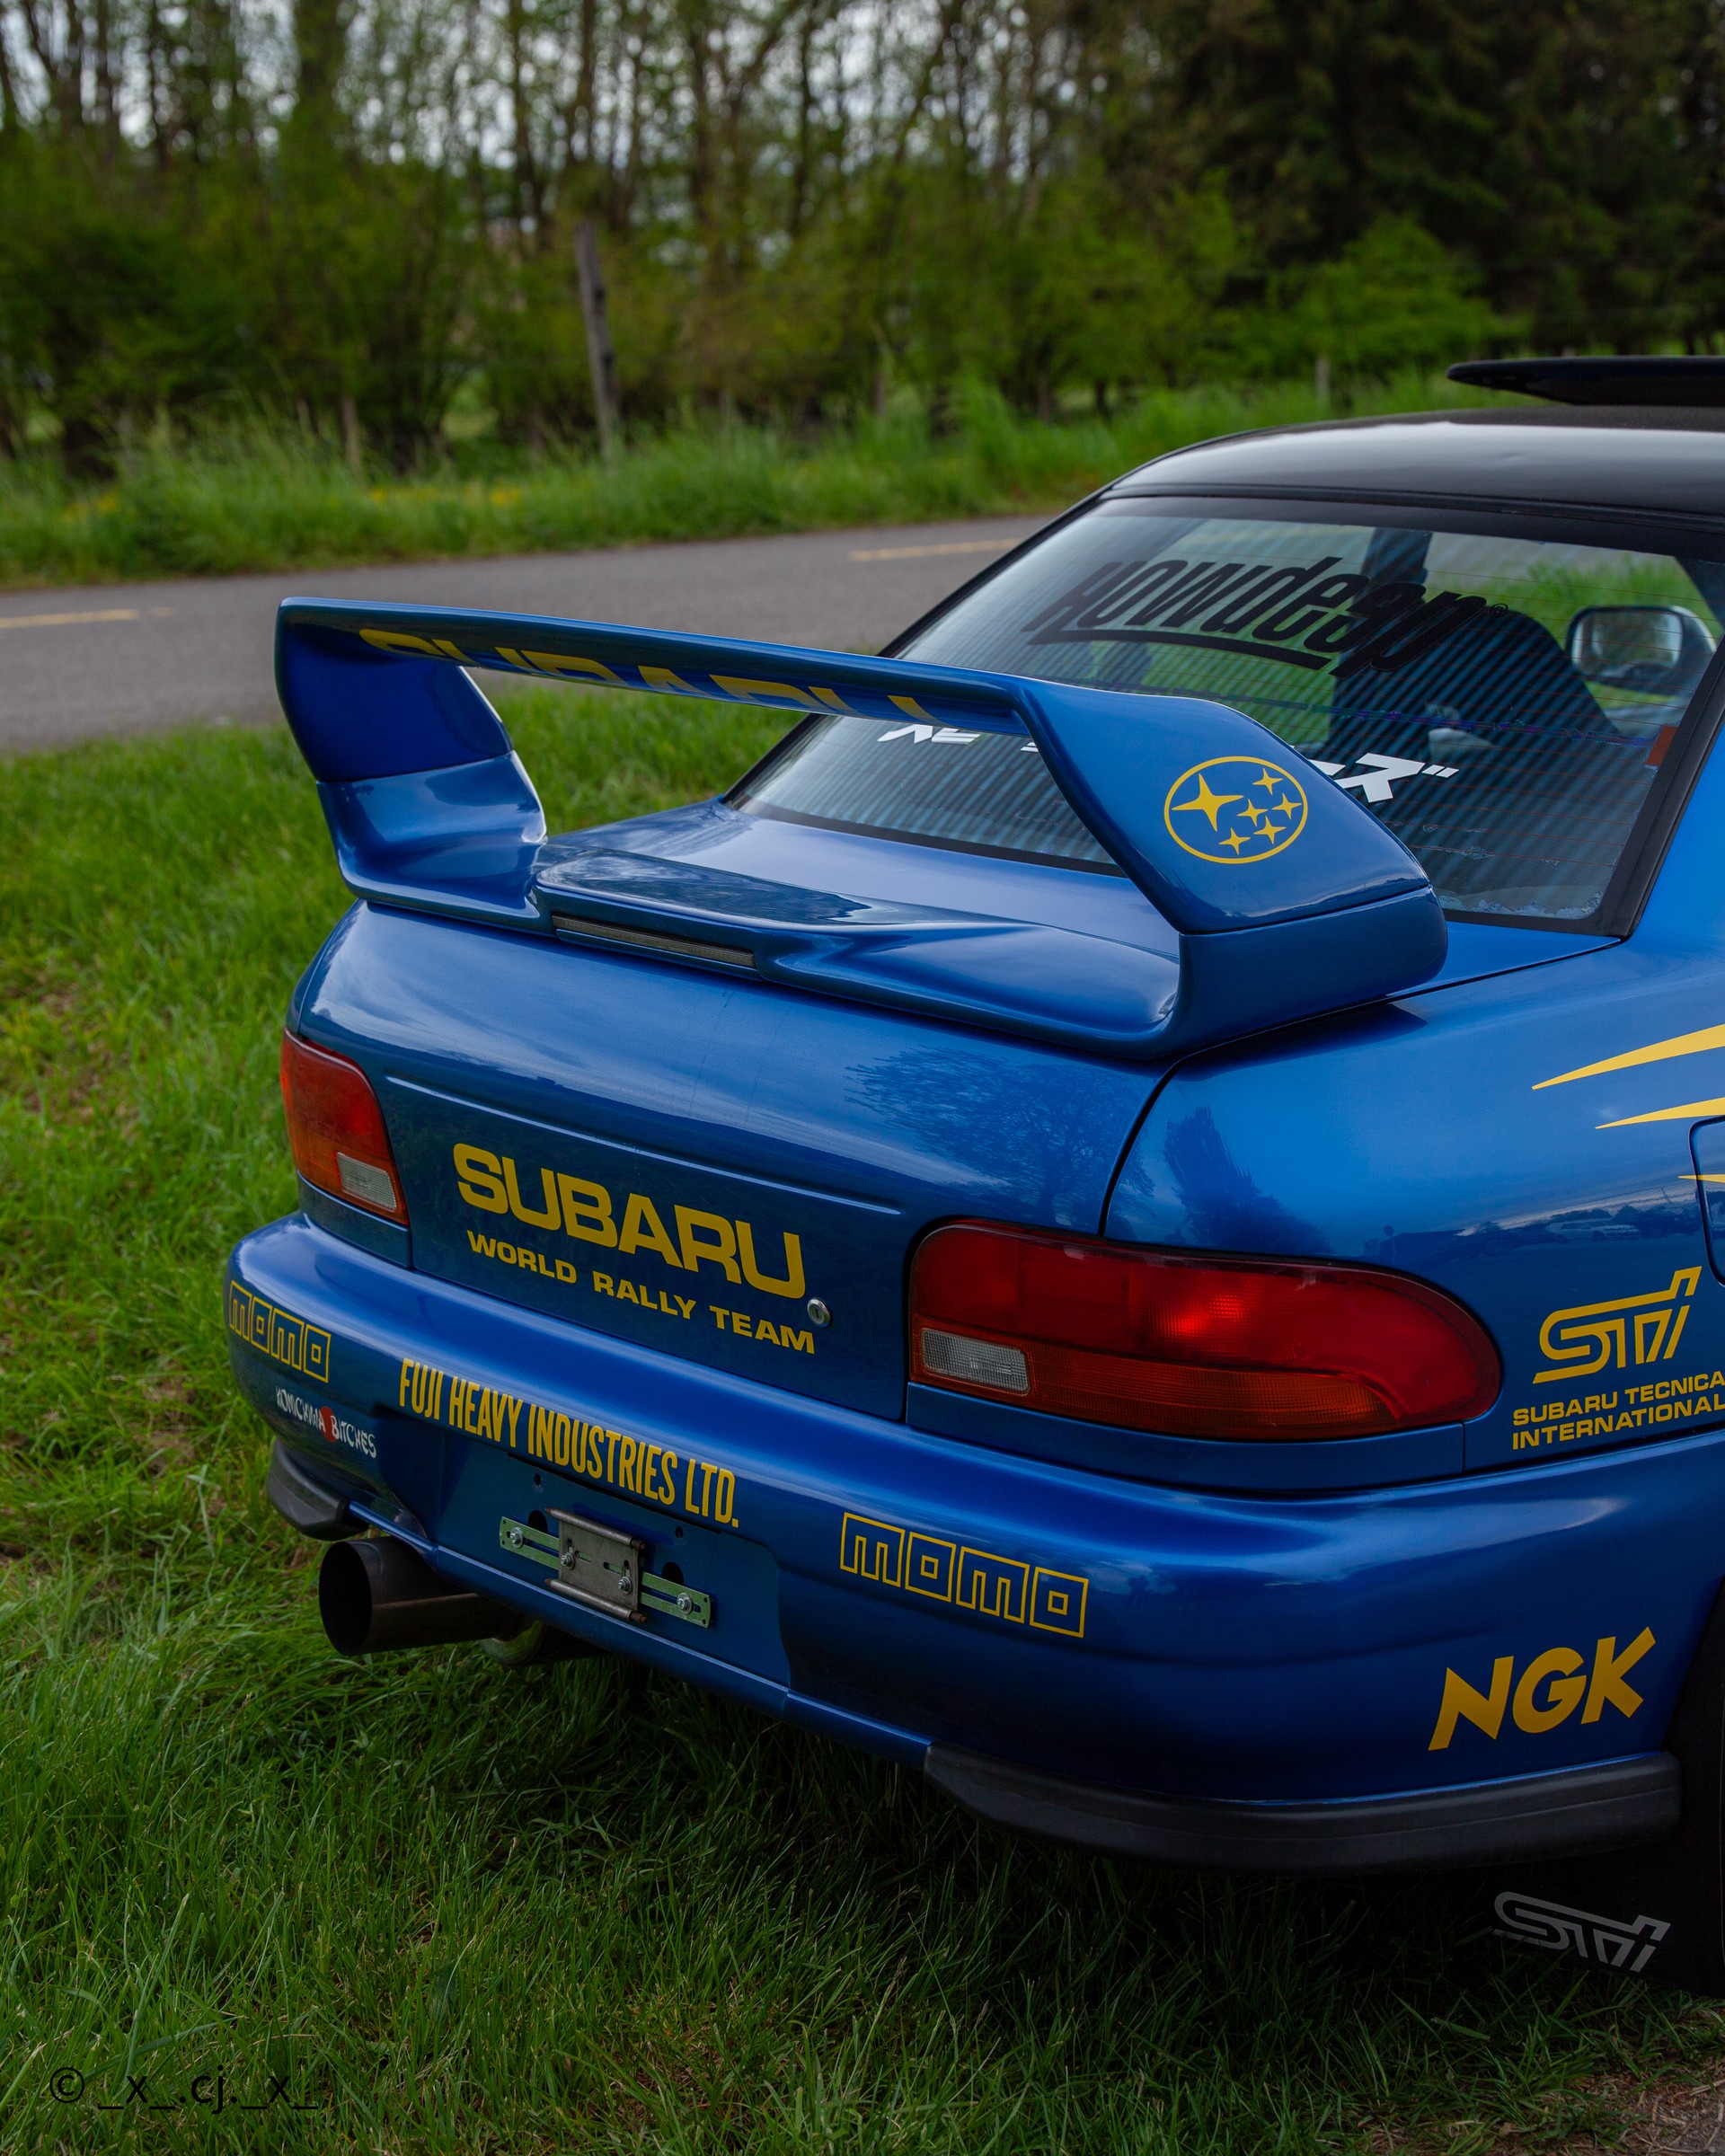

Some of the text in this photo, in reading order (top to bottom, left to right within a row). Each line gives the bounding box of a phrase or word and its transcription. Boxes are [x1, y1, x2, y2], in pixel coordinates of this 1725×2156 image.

[453, 1143, 805, 1299] SUBARU
[466, 1230, 815, 1355] WORLD RALLY TEAM
[330, 1415, 377, 1459] BITCHES
[399, 1358, 739, 1528] FUJI HEAVY INDUSTRIES LTD.
[1512, 1370, 1725, 1427] SUBARU TECNICA
[1512, 1392, 1725, 1451] INTERNATIONAL
[1428, 1626, 1656, 1751] NGK
